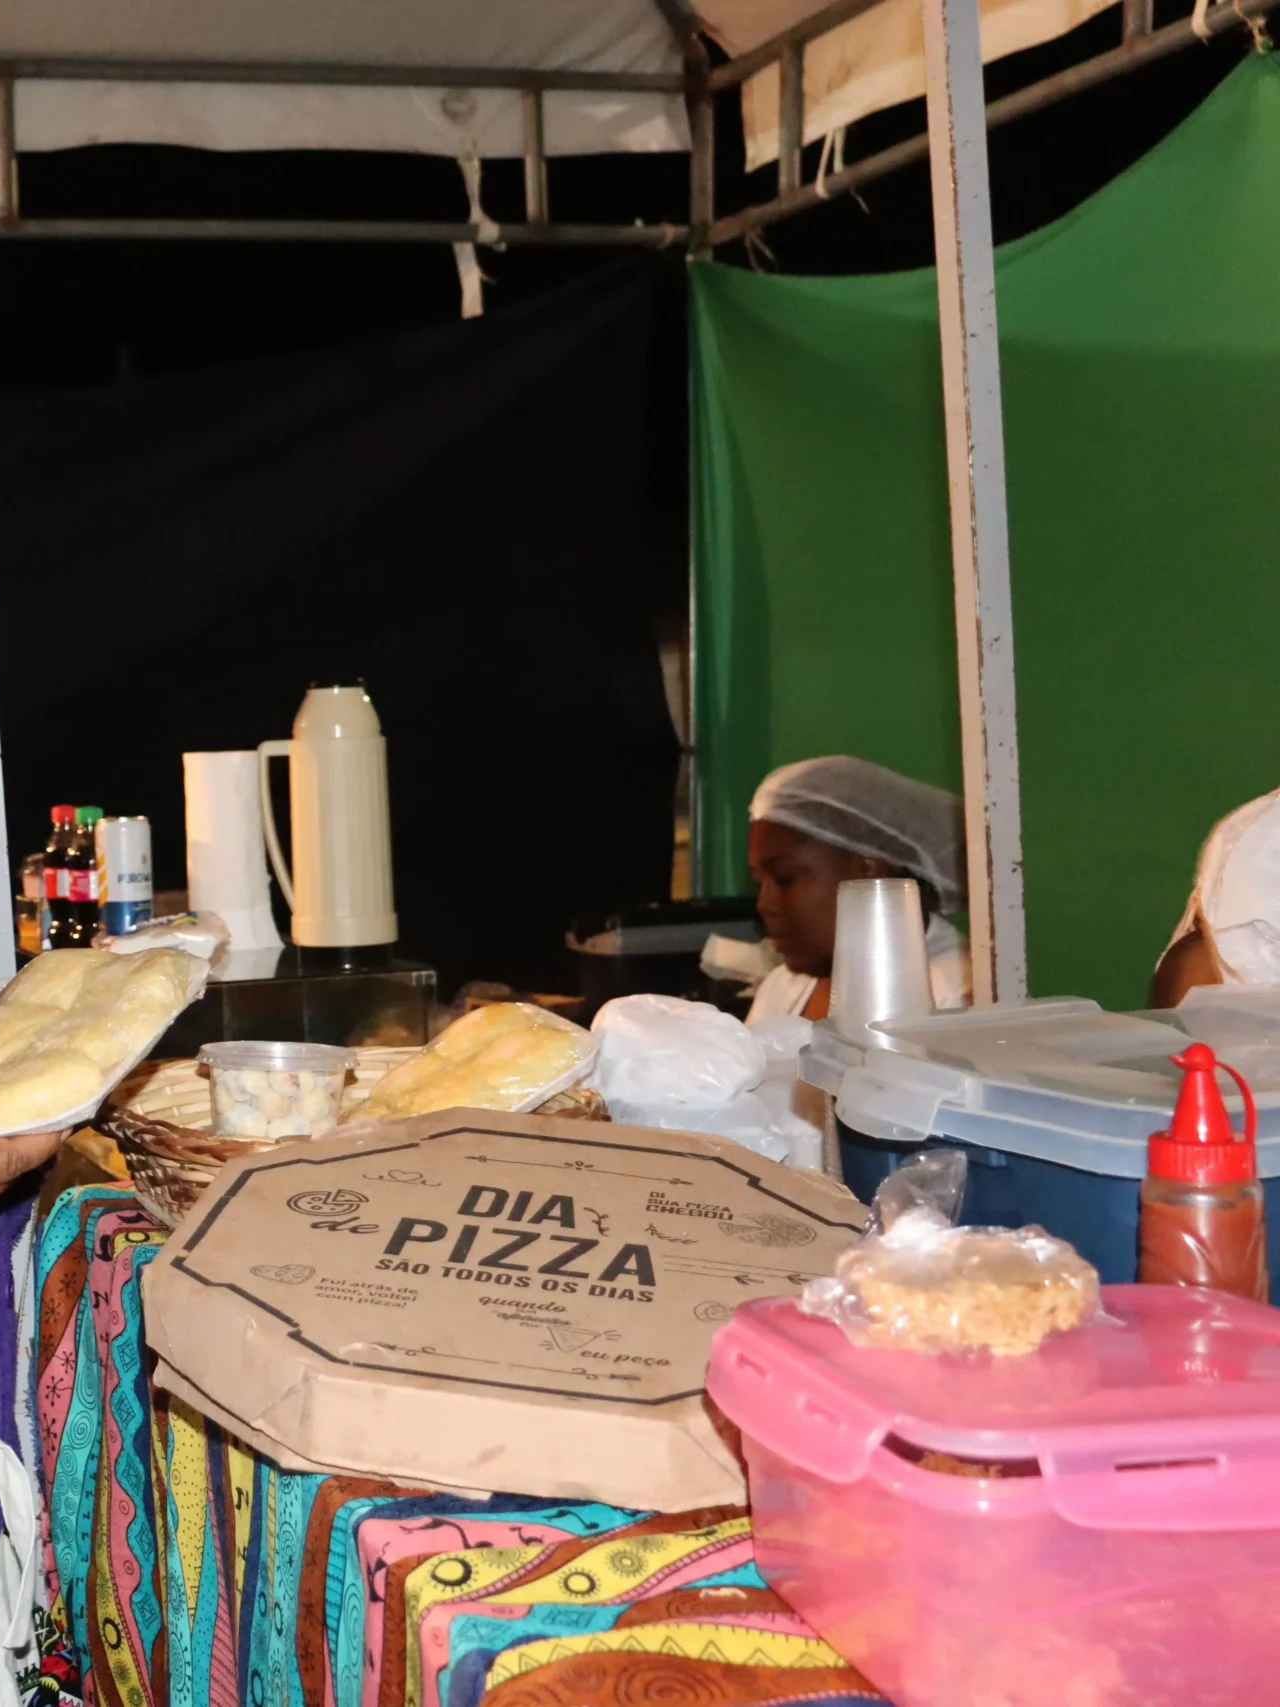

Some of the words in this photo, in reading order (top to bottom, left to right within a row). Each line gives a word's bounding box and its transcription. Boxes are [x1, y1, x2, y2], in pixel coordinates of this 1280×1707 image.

[457, 1184, 576, 1229] DIA
[645, 1204, 733, 1220] CHEGOU
[310, 1216, 380, 1235] de
[383, 1217, 656, 1287] PIZZA
[375, 1257, 430, 1275] SÃO
[441, 1266, 531, 1289] TODOS
[540, 1278, 580, 1294] OS
[588, 1284, 655, 1303] DIAS
[397, 1287, 418, 1295] de
[315, 1292, 354, 1302] com
[357, 1297, 407, 1308] pizza!
[478, 1296, 567, 1313] quando
[580, 1349, 609, 1360] eu
[613, 1351, 672, 1367] peço
